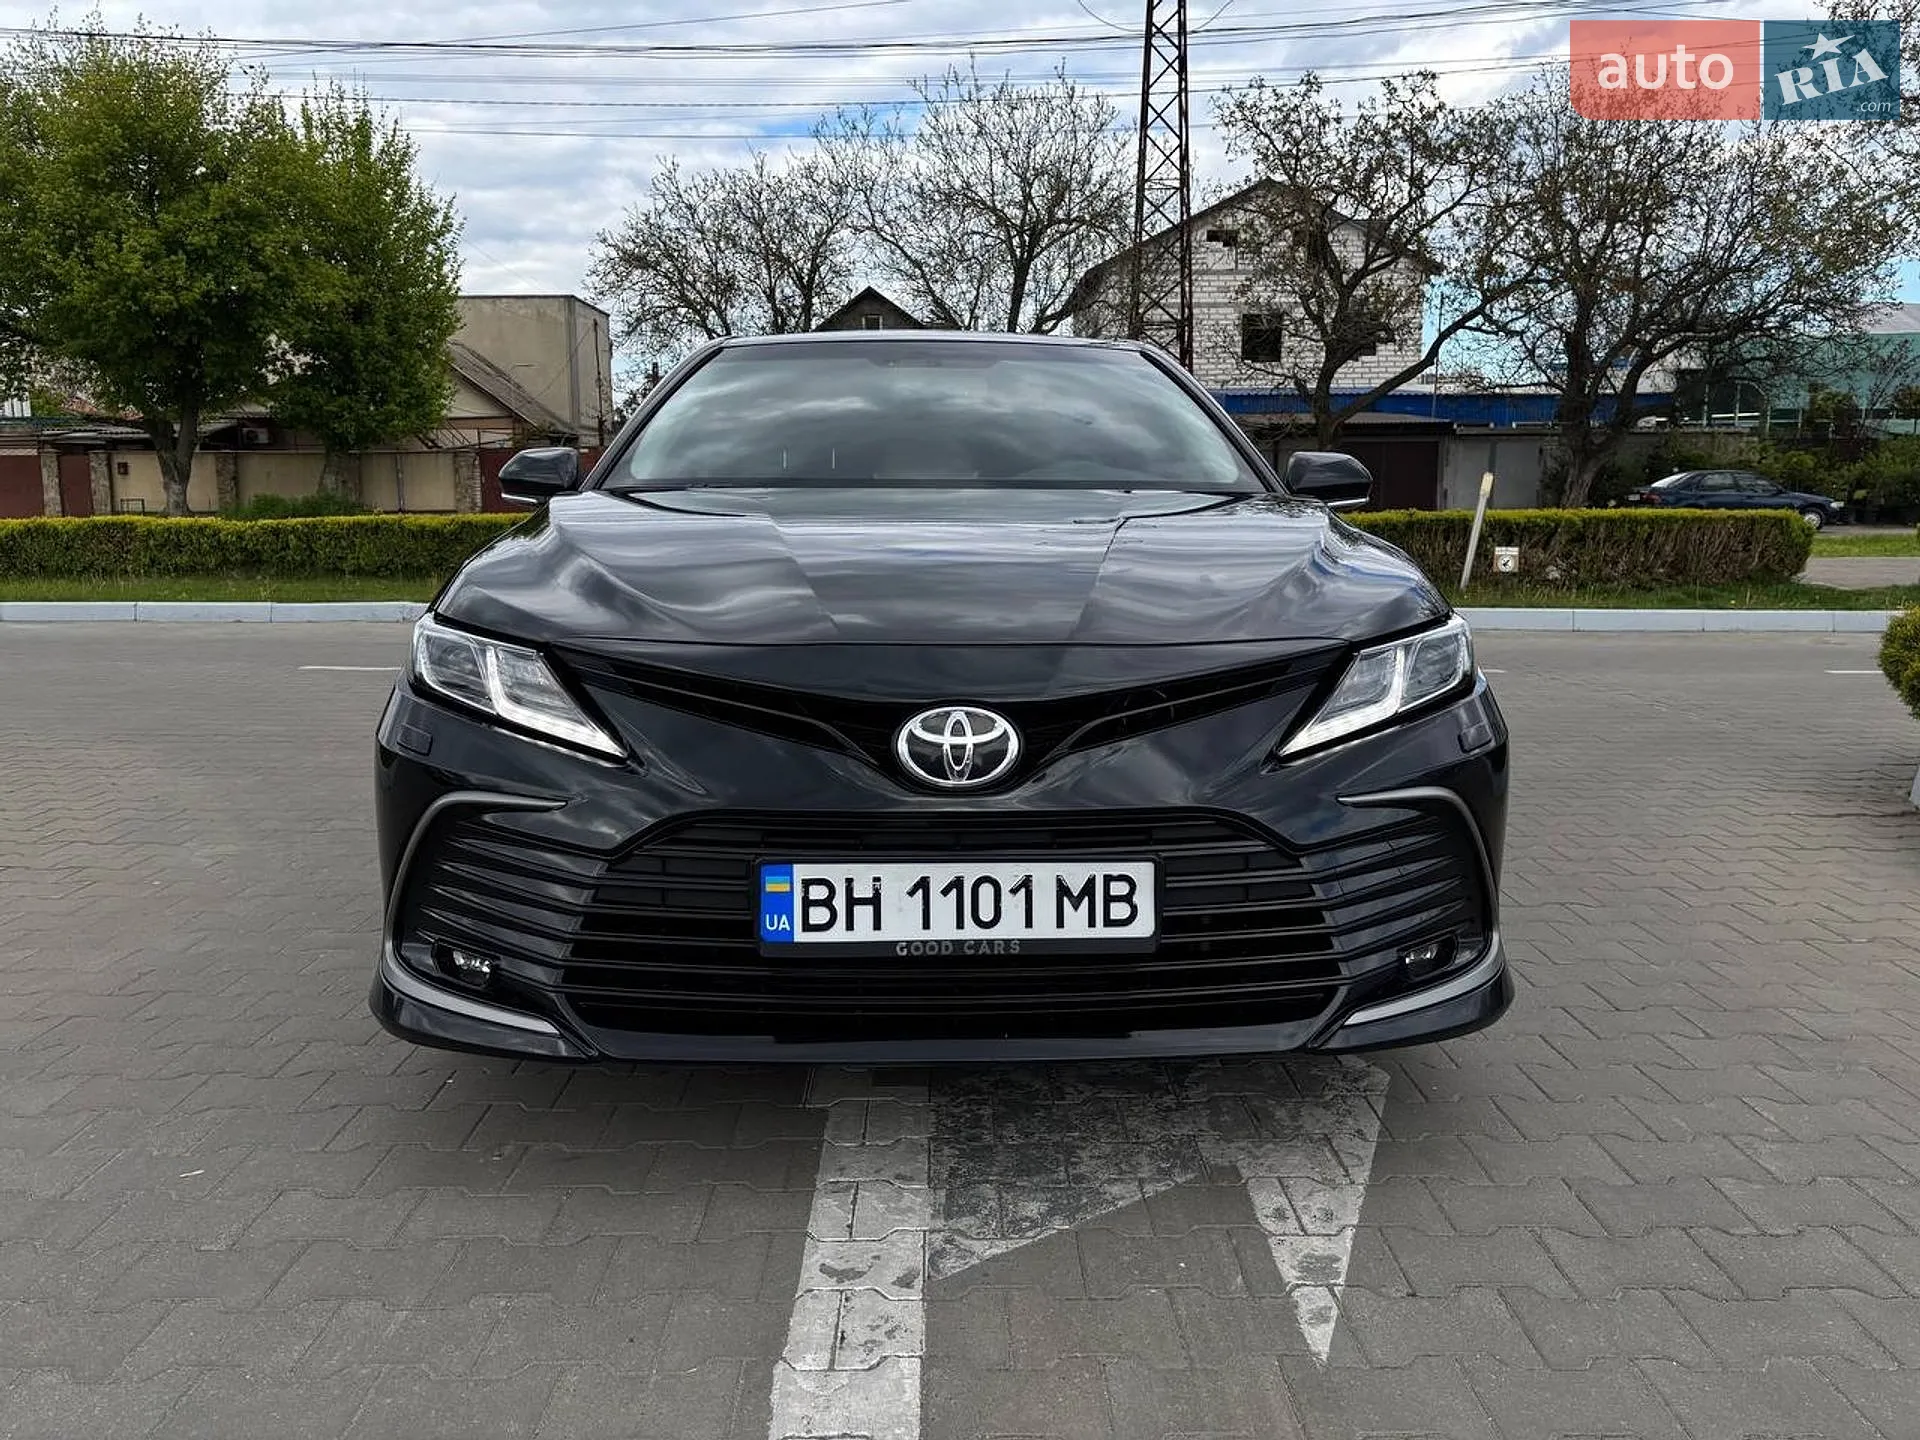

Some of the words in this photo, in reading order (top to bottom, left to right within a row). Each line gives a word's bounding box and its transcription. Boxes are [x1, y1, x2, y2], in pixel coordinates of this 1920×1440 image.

[801, 876, 882, 933] BH
[906, 874, 1034, 930] 1101
[1056, 873, 1139, 929] MB
[766, 914, 791, 932] UA
[896, 940, 955, 957] GOOD
[964, 939, 1021, 956] CARS
